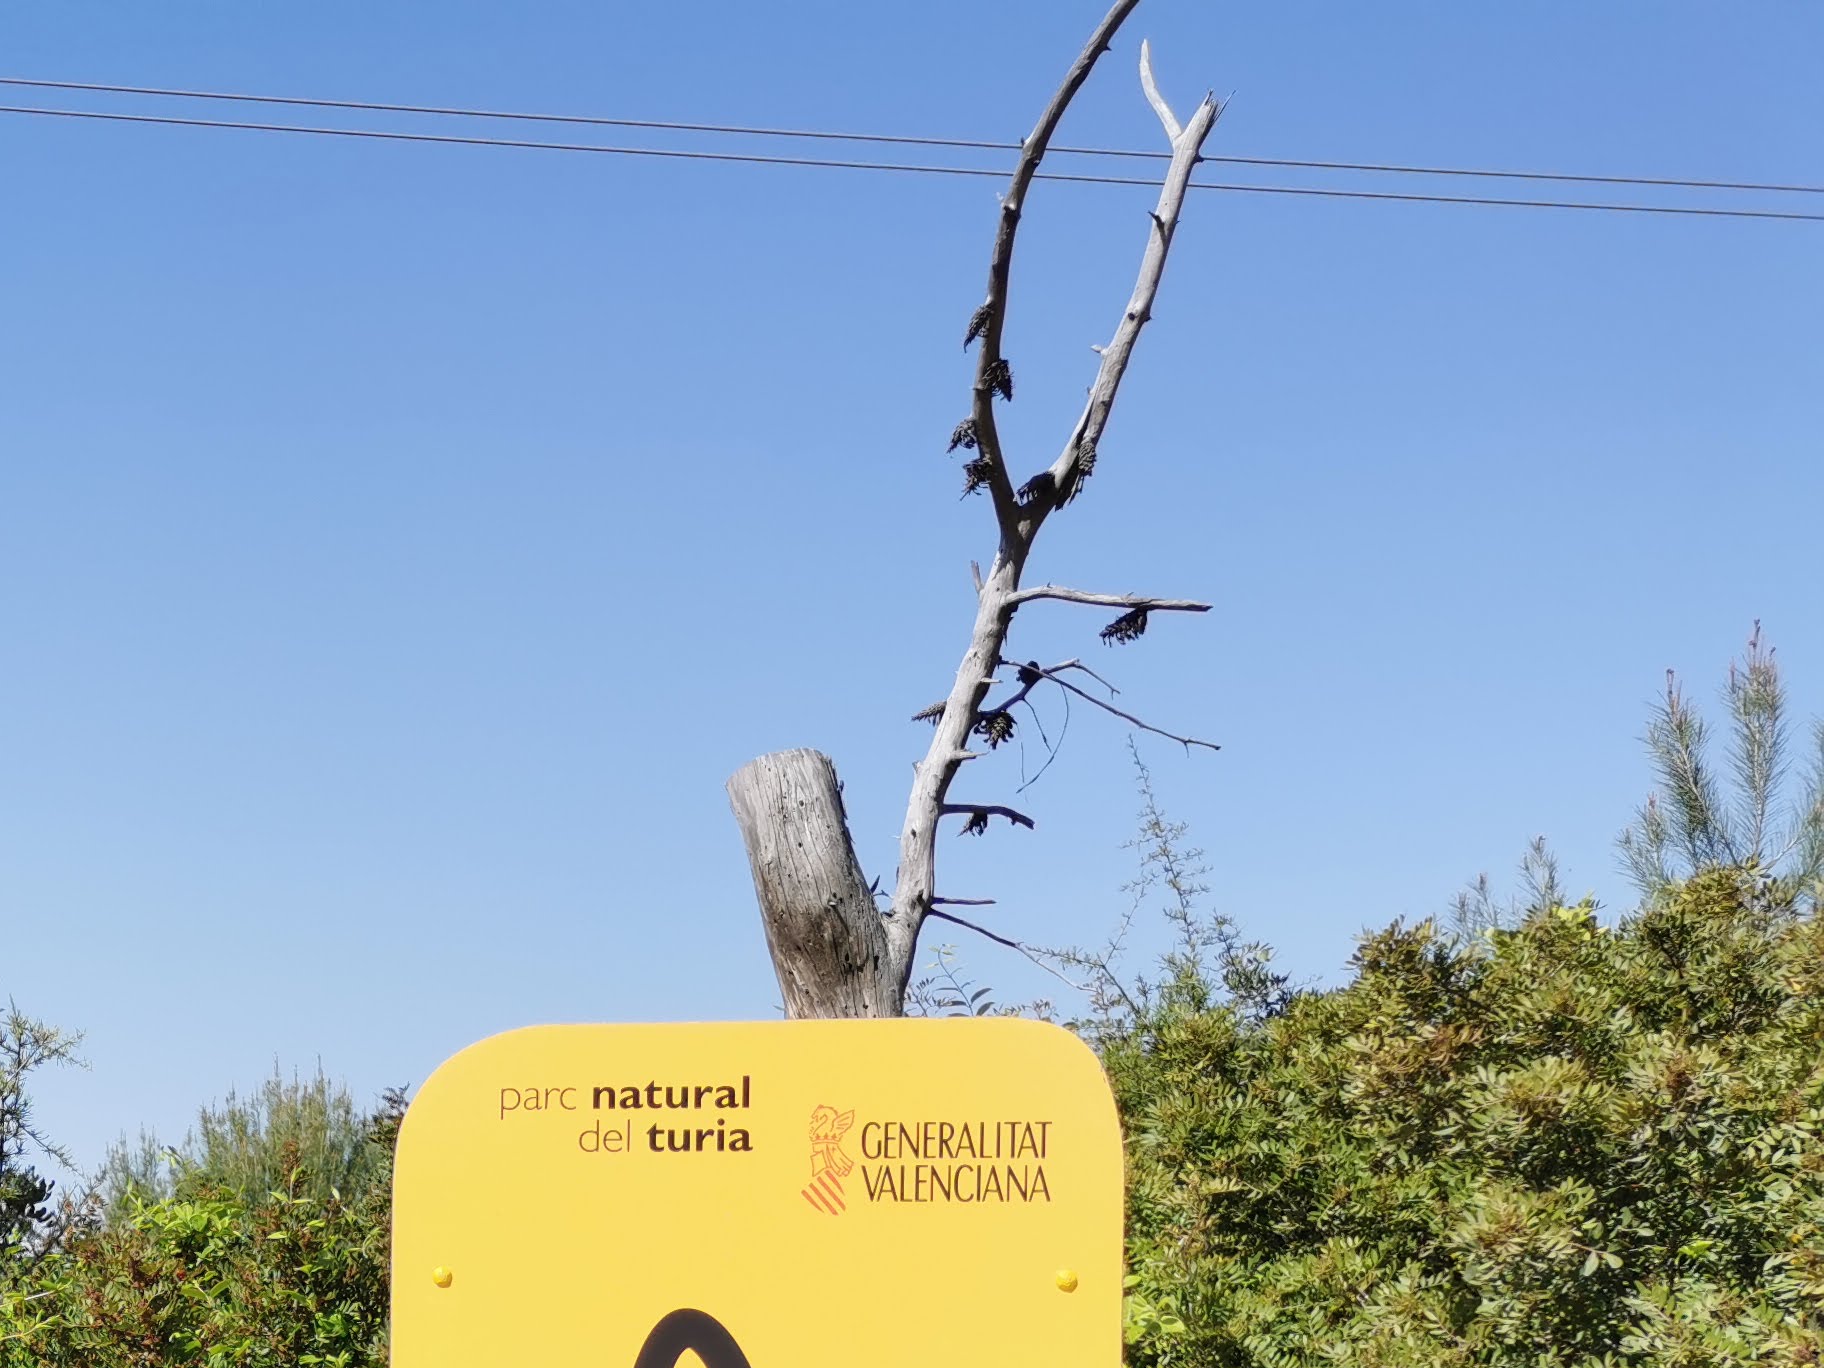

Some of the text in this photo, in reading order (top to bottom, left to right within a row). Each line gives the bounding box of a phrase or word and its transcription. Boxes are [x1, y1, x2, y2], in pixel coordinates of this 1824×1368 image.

[500, 1075, 751, 1120] parc natural
[578, 1118, 753, 1153] del turia
[861, 1121, 1052, 1159] GENERALITAT
[861, 1164, 1051, 1203] VALENCIANA
